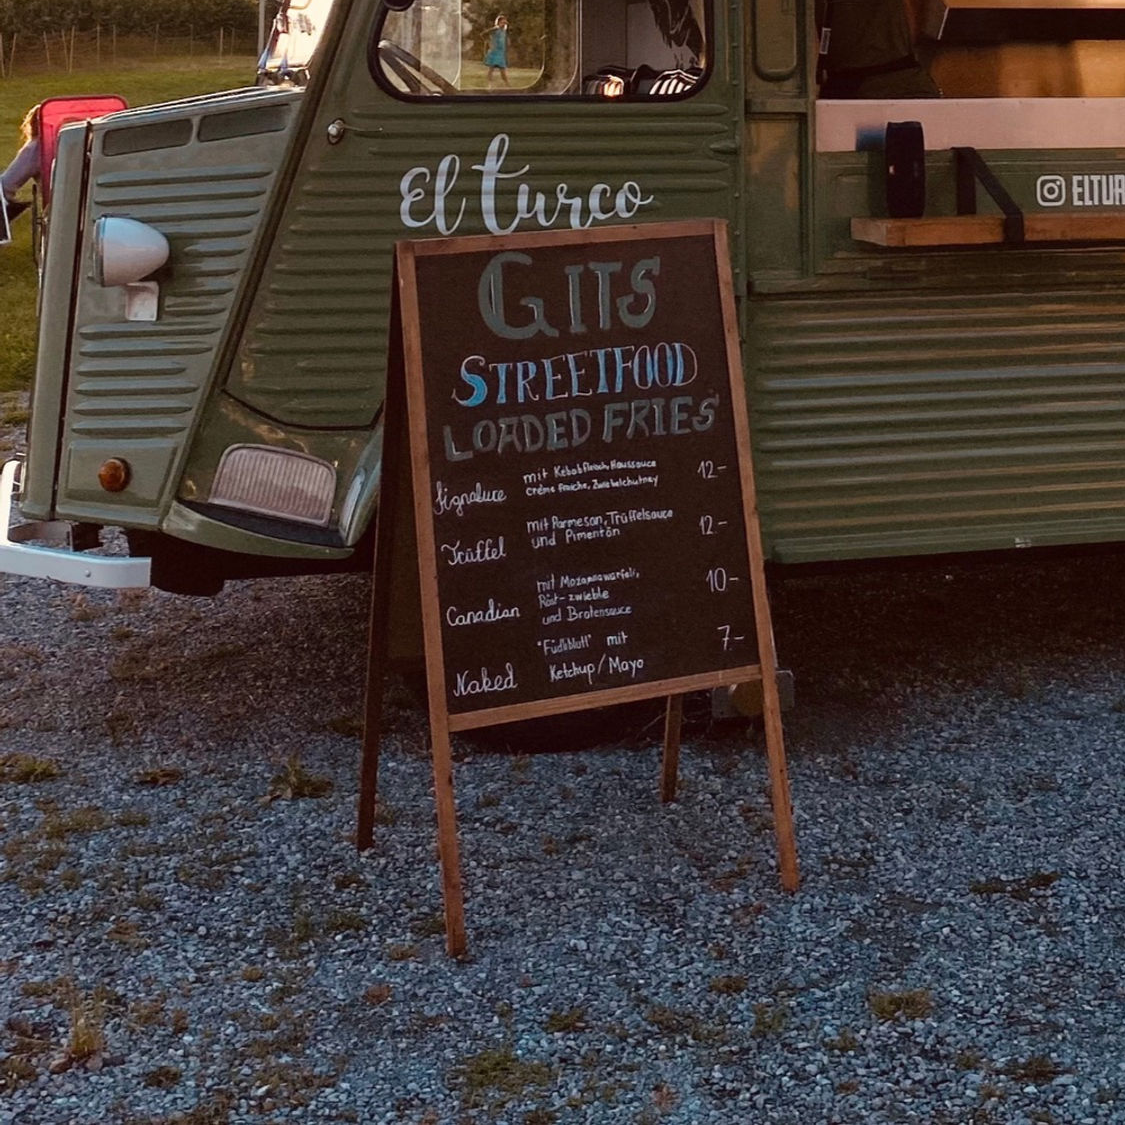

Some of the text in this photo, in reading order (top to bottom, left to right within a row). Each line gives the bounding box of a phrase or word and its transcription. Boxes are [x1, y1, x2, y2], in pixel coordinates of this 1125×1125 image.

[400, 133, 654, 236] El turco
[478, 250, 661, 340] GITS
[451, 342, 698, 407] STREETFOOD
[443, 393, 720, 462] LOADED FRIES
[523, 467, 549, 484] mit
[433, 481, 507, 516] Signature
[526, 517, 550, 533] mit
[531, 531, 556, 550] und
[536, 573, 555, 593] mit
[446, 598, 521, 627] Canadian
[542, 607, 562, 626] und
[606, 631, 629, 646] mit
[453, 662, 519, 697] Naked
